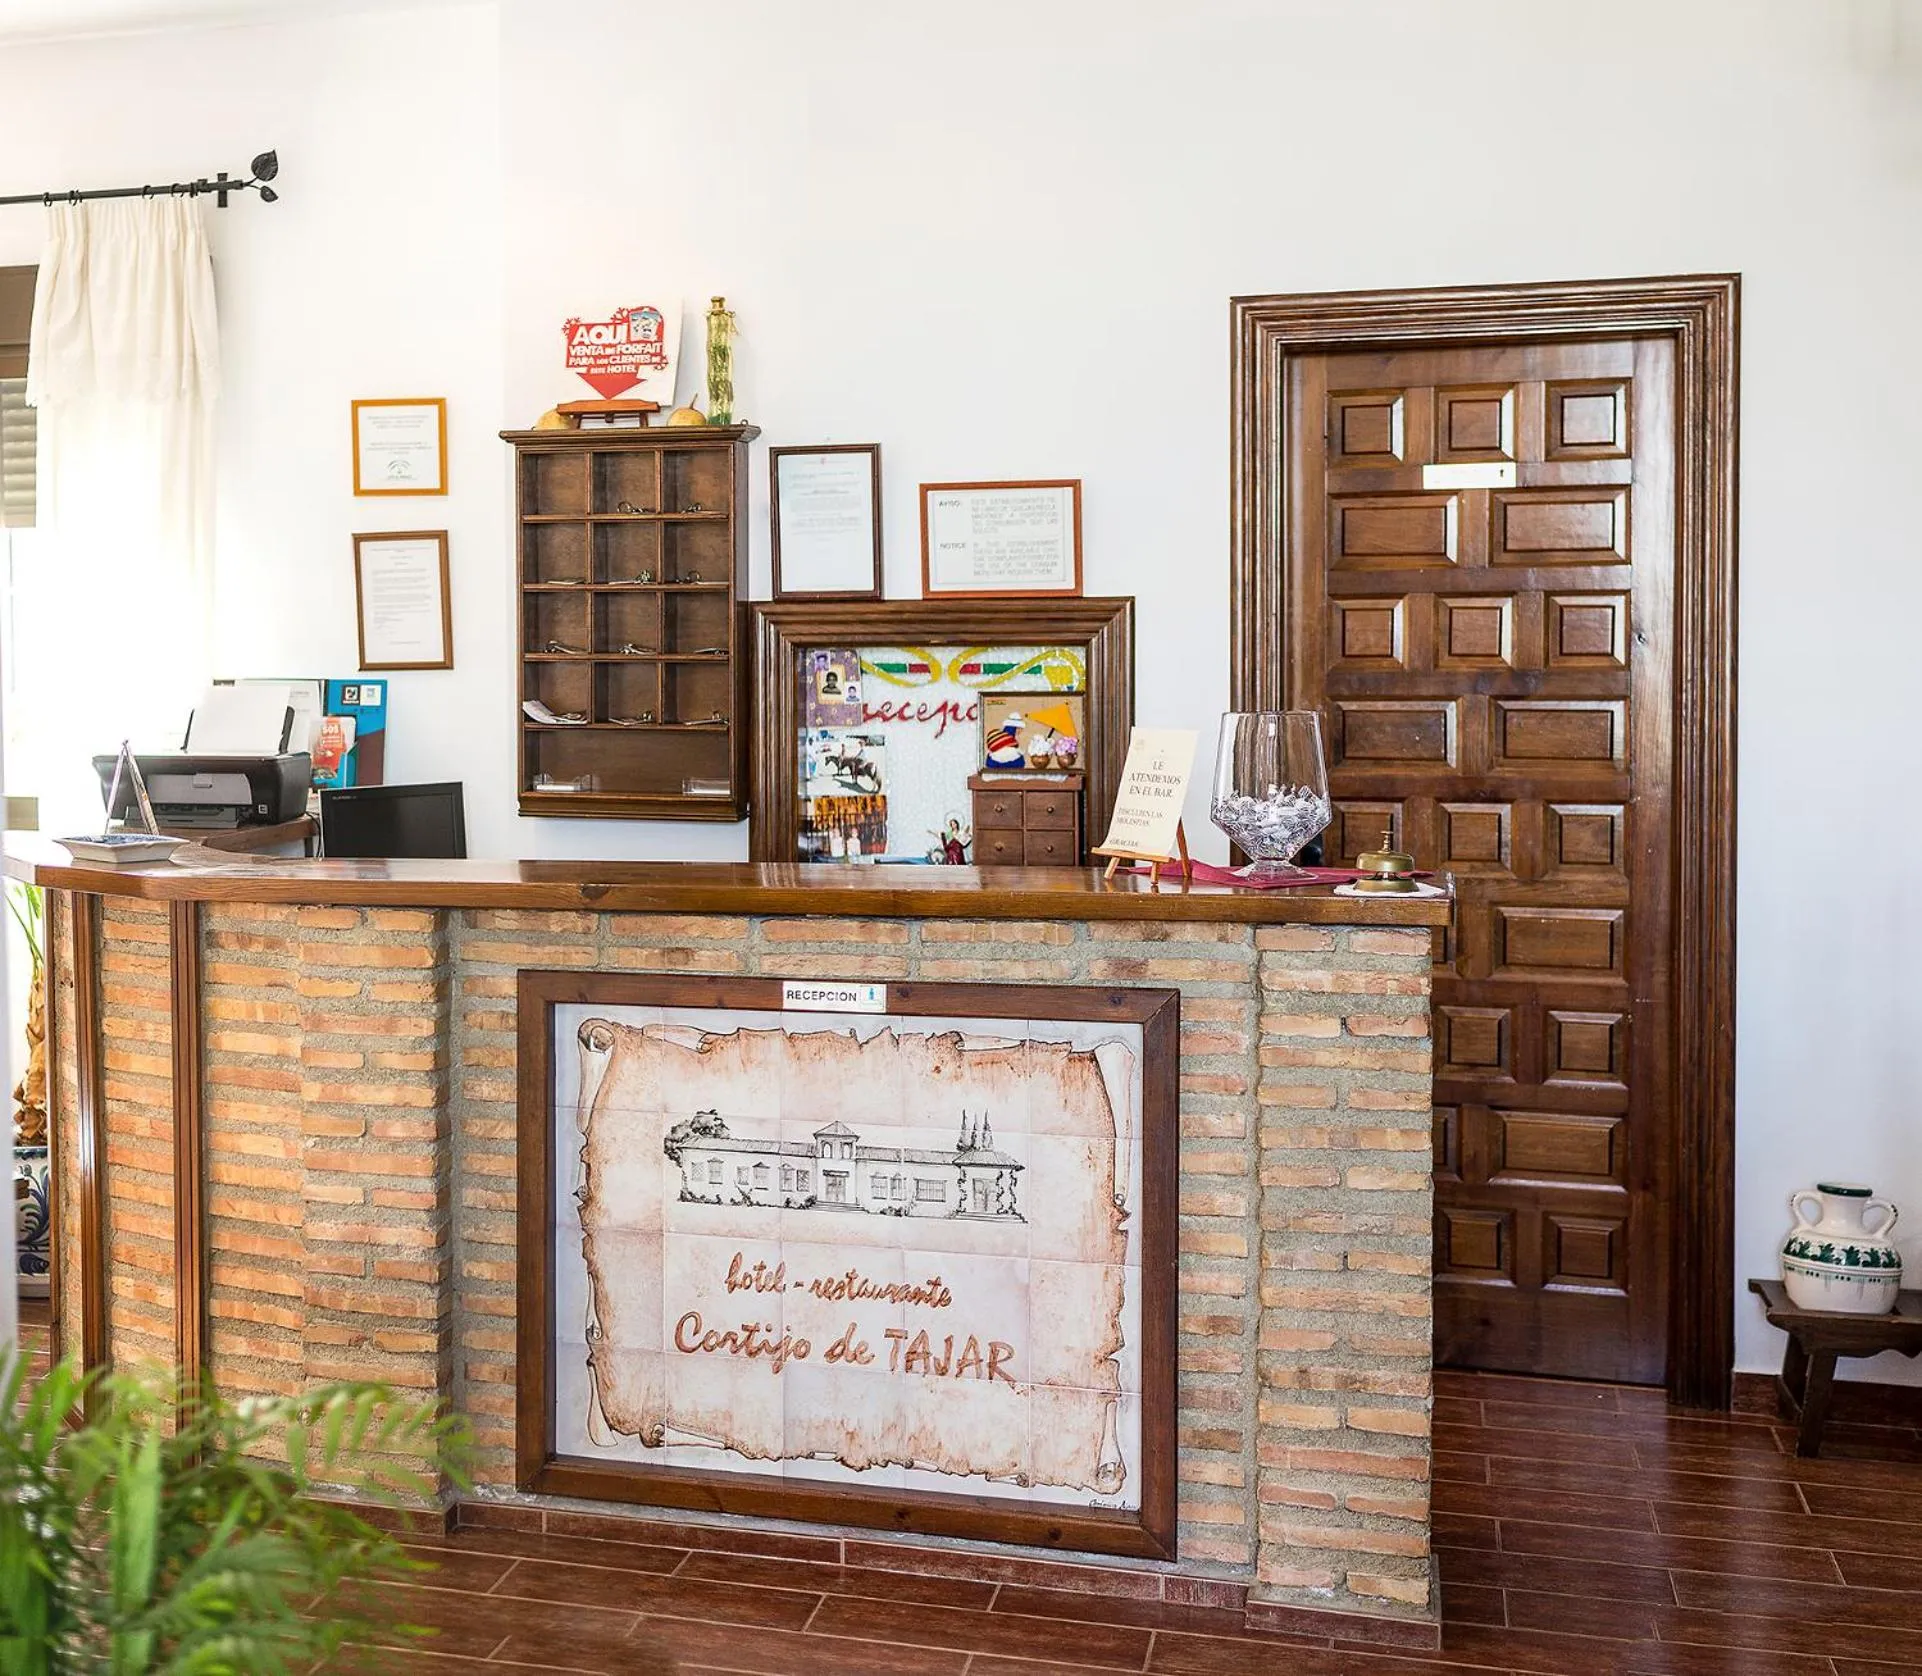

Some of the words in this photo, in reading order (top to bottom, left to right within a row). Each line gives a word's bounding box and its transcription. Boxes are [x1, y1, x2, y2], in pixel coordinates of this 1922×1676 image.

[569, 345, 604, 356] VENTA
[616, 342, 662, 355] FORFAIT
[569, 357, 594, 365] PARA
[609, 355, 650, 363] CLIENTES
[607, 364, 637, 373] HOTEL
[1152, 761, 1166, 770] LE
[1129, 772, 1181, 785] ATENDEMOS
[1129, 785, 1141, 795] EN
[1142, 786, 1153, 796] EL
[786, 990, 857, 1002] RECEPCION
[725, 1251, 786, 1294] hotel
[808, 1268, 952, 1308] restaurante
[674, 1311, 812, 1374] Cortijo
[824, 1321, 875, 1365] de
[884, 1328, 1018, 1388] TAJAR
